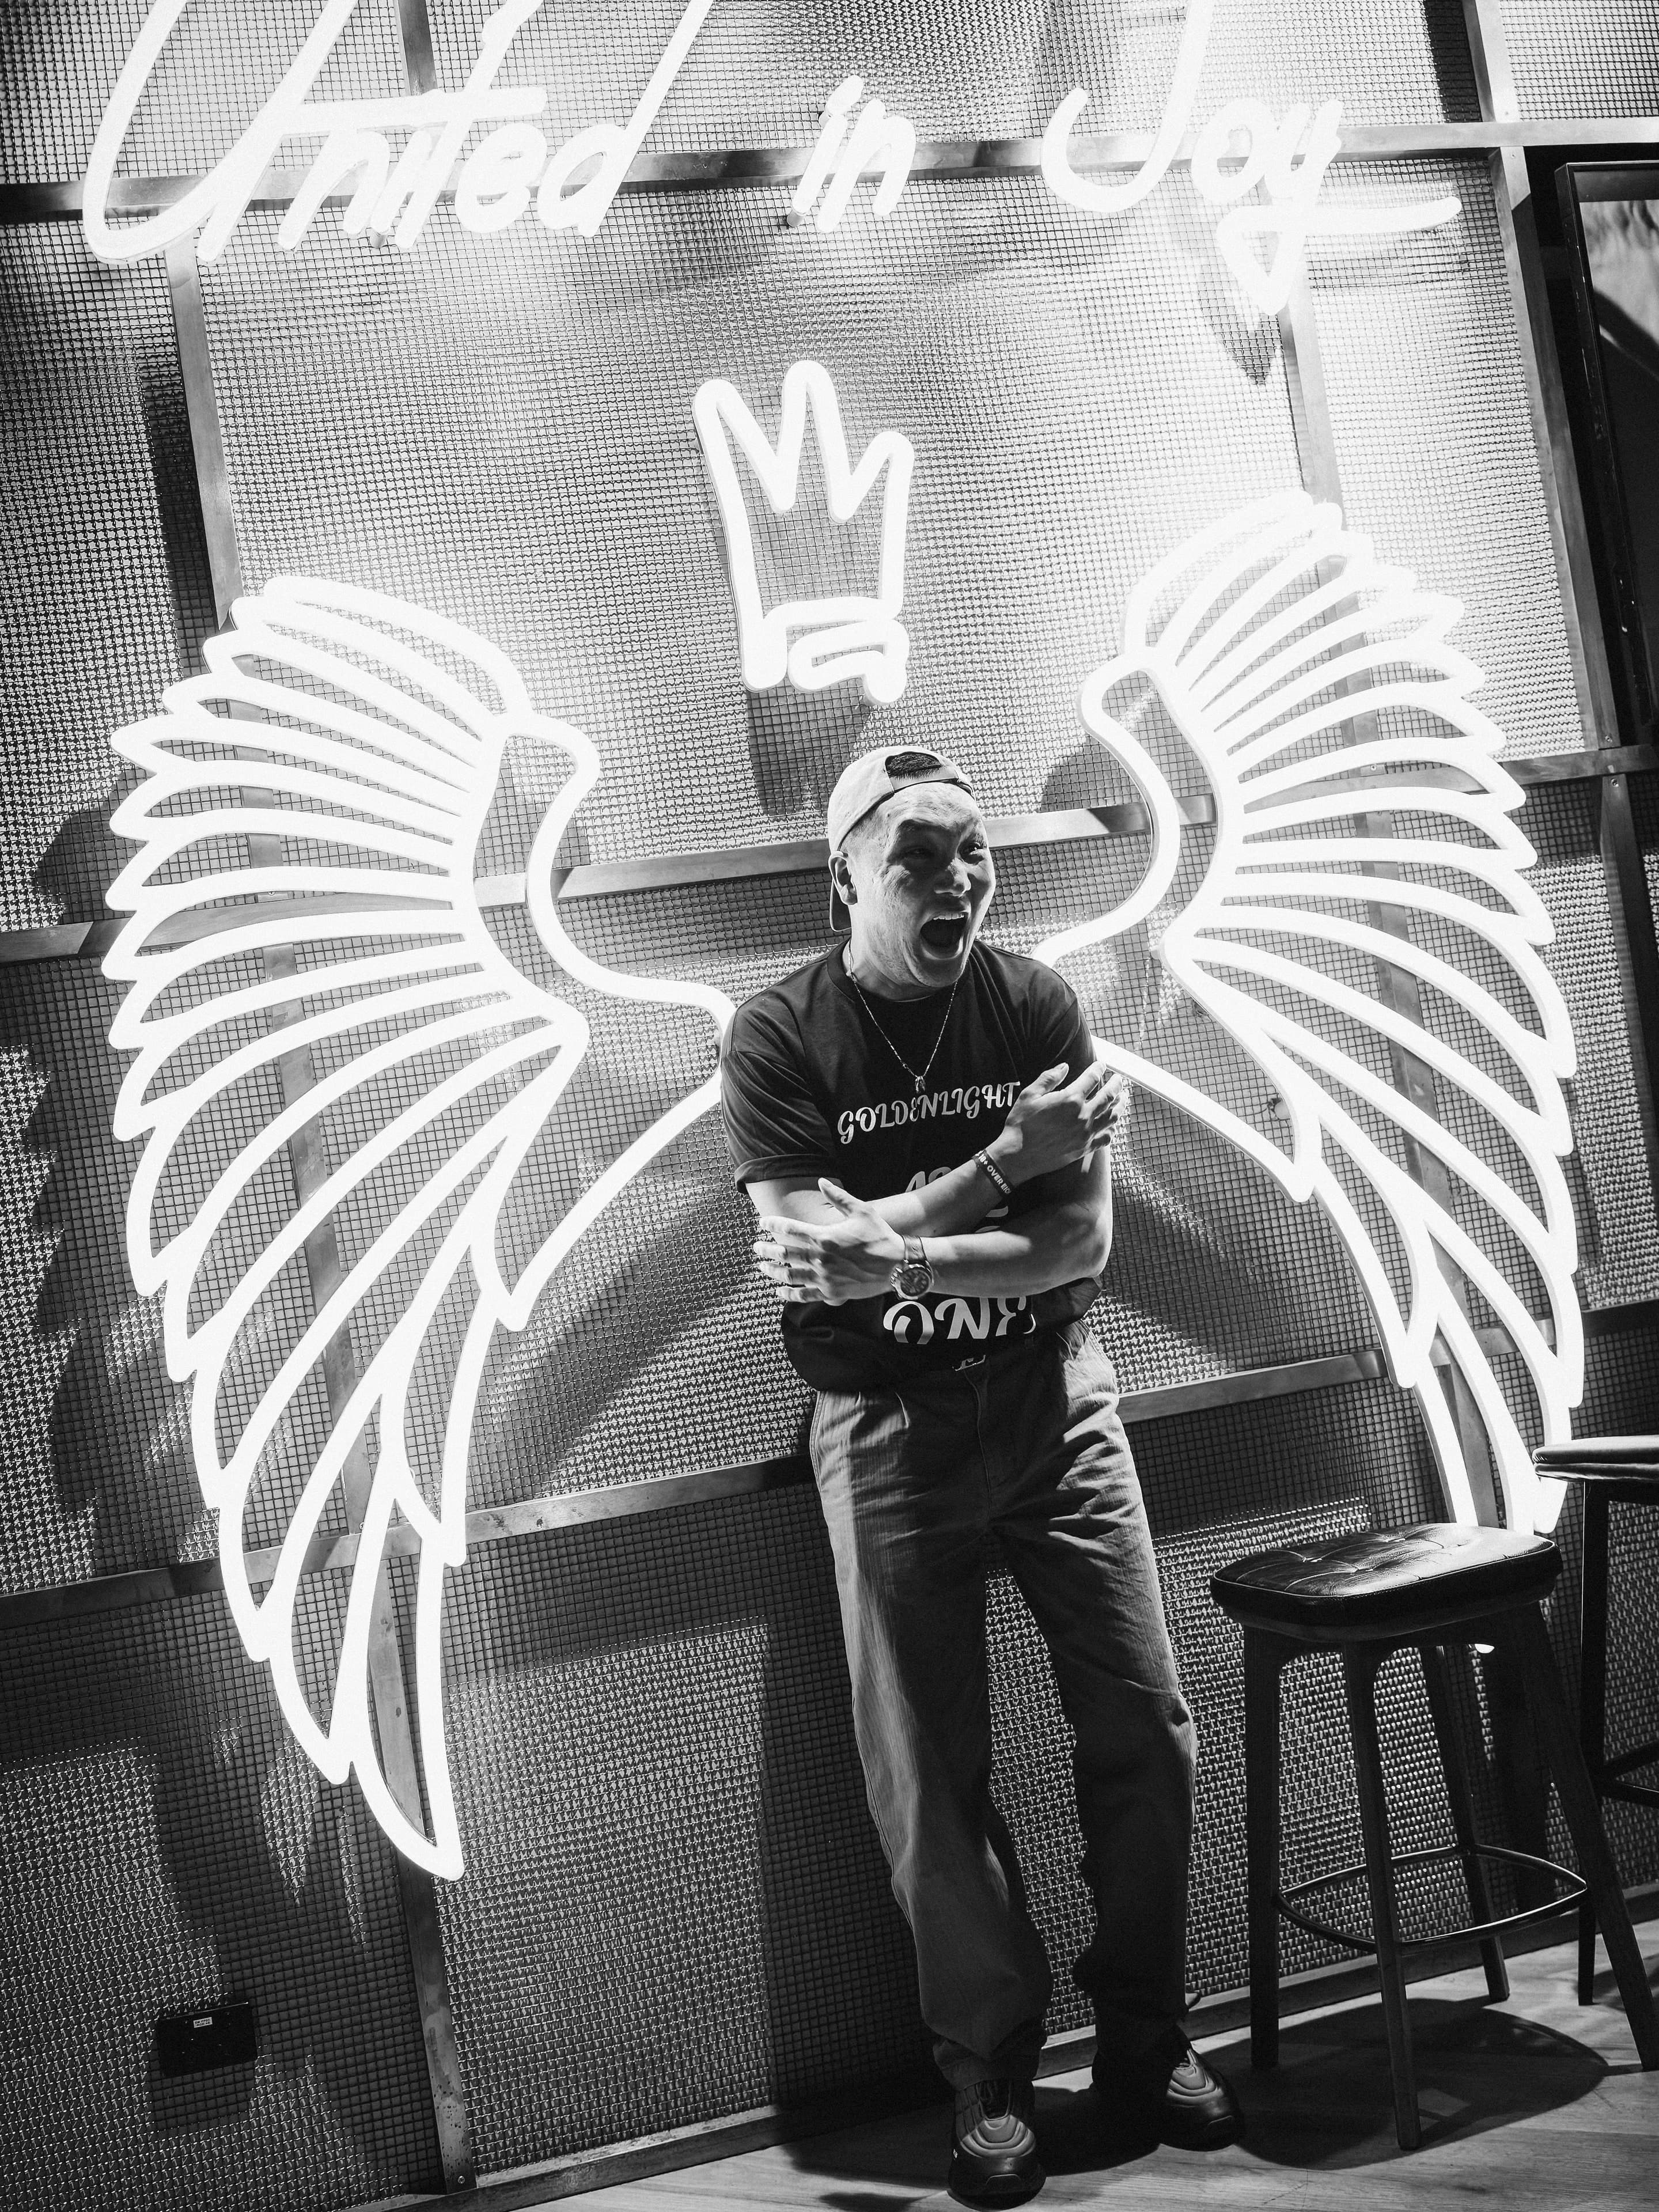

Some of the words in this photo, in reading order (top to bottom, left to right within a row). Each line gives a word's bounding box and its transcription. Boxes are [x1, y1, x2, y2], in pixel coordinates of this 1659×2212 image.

[82, 0, 714, 263] United
[790, 74, 916, 232] in
[1040, 0, 1463, 316] Joy
[837, 1081, 1021, 1144] GOLDENLIGHT
[986, 1165, 1003, 1185] OVER
